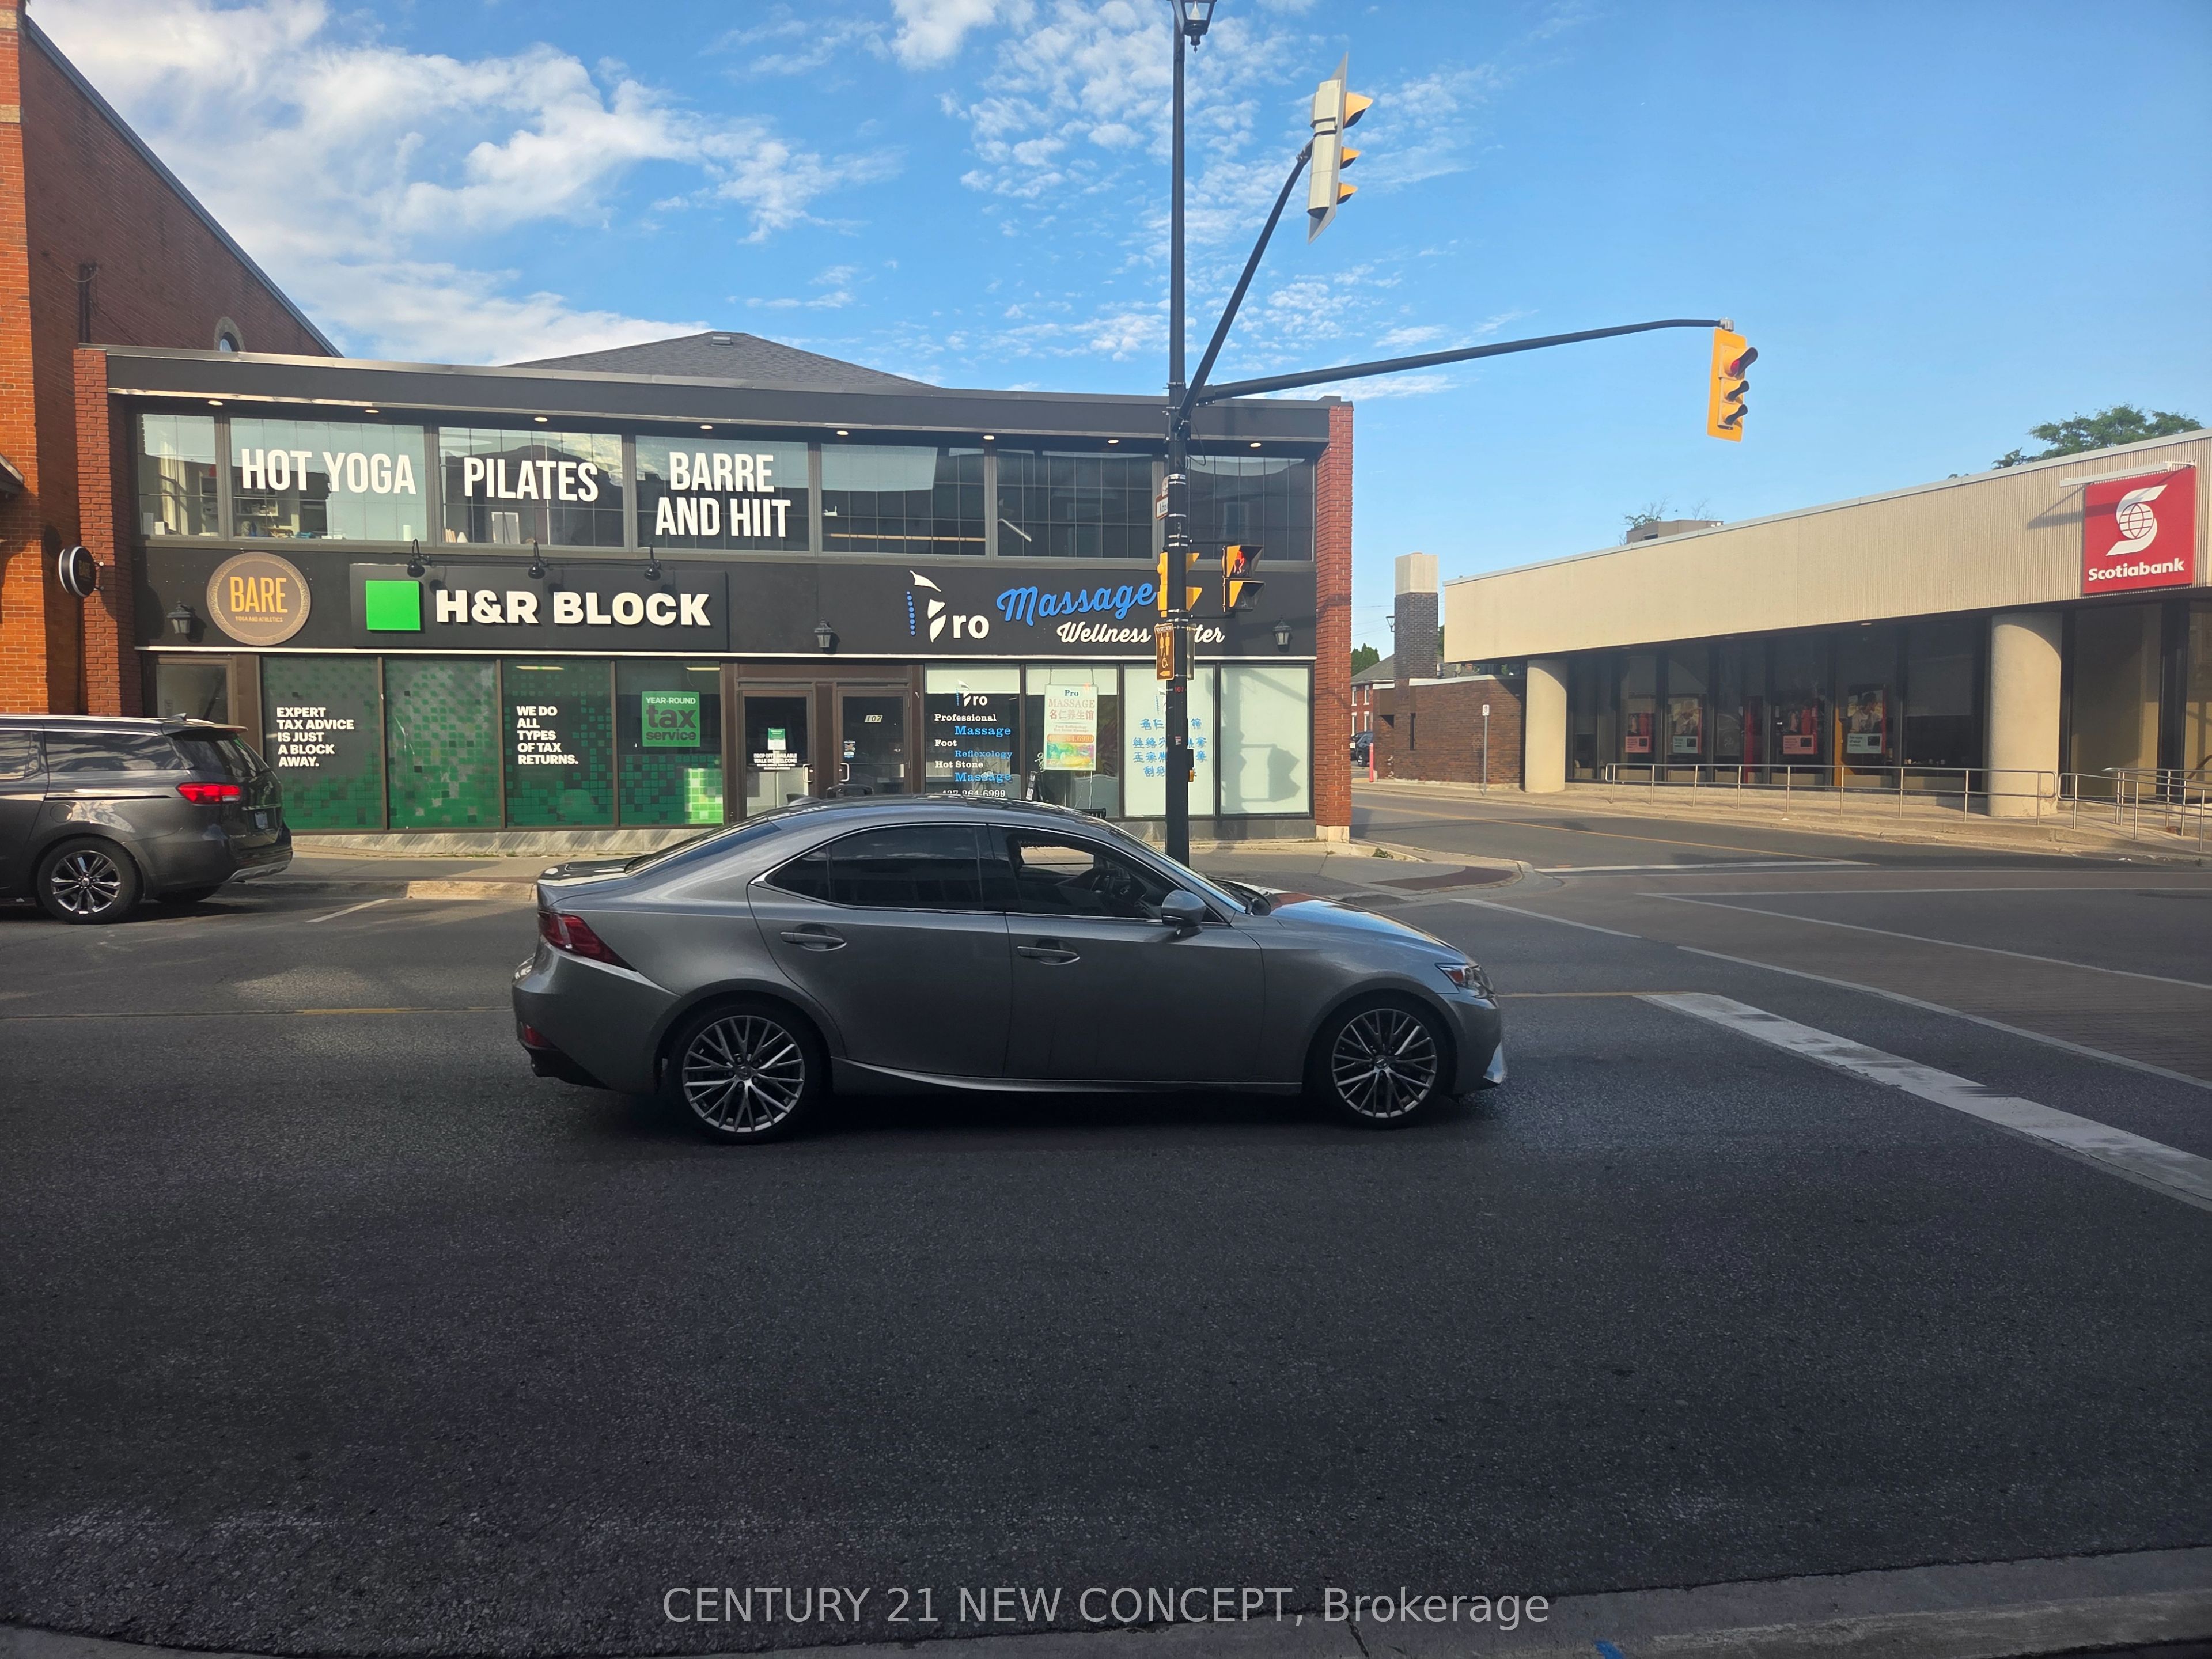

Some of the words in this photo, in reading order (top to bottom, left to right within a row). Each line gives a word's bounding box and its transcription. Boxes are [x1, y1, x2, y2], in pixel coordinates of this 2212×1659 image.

[241, 449, 312, 491] HOT
[322, 452, 416, 495] YOGA
[669, 452, 775, 493] BARRE
[464, 457, 599, 502] PILATES
[655, 497, 721, 536] AND
[730, 498, 791, 537] HIIT
[2088, 557, 2185, 581] Scotiabank
[230, 576, 288, 613] BARE
[436, 589, 539, 624] H&R
[554, 592, 711, 626] BLOCK
[997, 583, 1157, 626] Massage
[1056, 622, 1151, 643] Wellness
[646, 696, 696, 704] YEAR-ROUND
[1048, 698, 1095, 708] MASSAGE
[276, 707, 327, 718] EXPERT
[516, 706, 537, 716] WE
[539, 706, 558, 716] DO
[646, 704, 696, 729] tax
[1050, 709, 1094, 721] 名仁养生馆
[934, 713, 997, 722] Professional
[277, 719, 304, 730] TAX
[305, 719, 355, 730] ADVICE
[517, 718, 540, 729] ALL
[517, 730, 556, 741] TYPES
[646, 729, 696, 741] service
[954, 725, 1011, 737] Massage
[278, 732, 291, 742] IS
[292, 732, 325, 742] JUST
[934, 738, 957, 747] Foot
[278, 744, 288, 755] A
[290, 744, 335, 755] BLOCK
[517, 743, 535, 753] OF
[539, 743, 562, 753] TAX
[518, 755, 579, 765] RETURNS.
[954, 750, 1013, 759] Reflexology
[278, 756, 320, 767] AWAY.
[934, 760, 953, 768] Hot
[955, 760, 983, 768] Stone
[954, 772, 1012, 783] Massage
